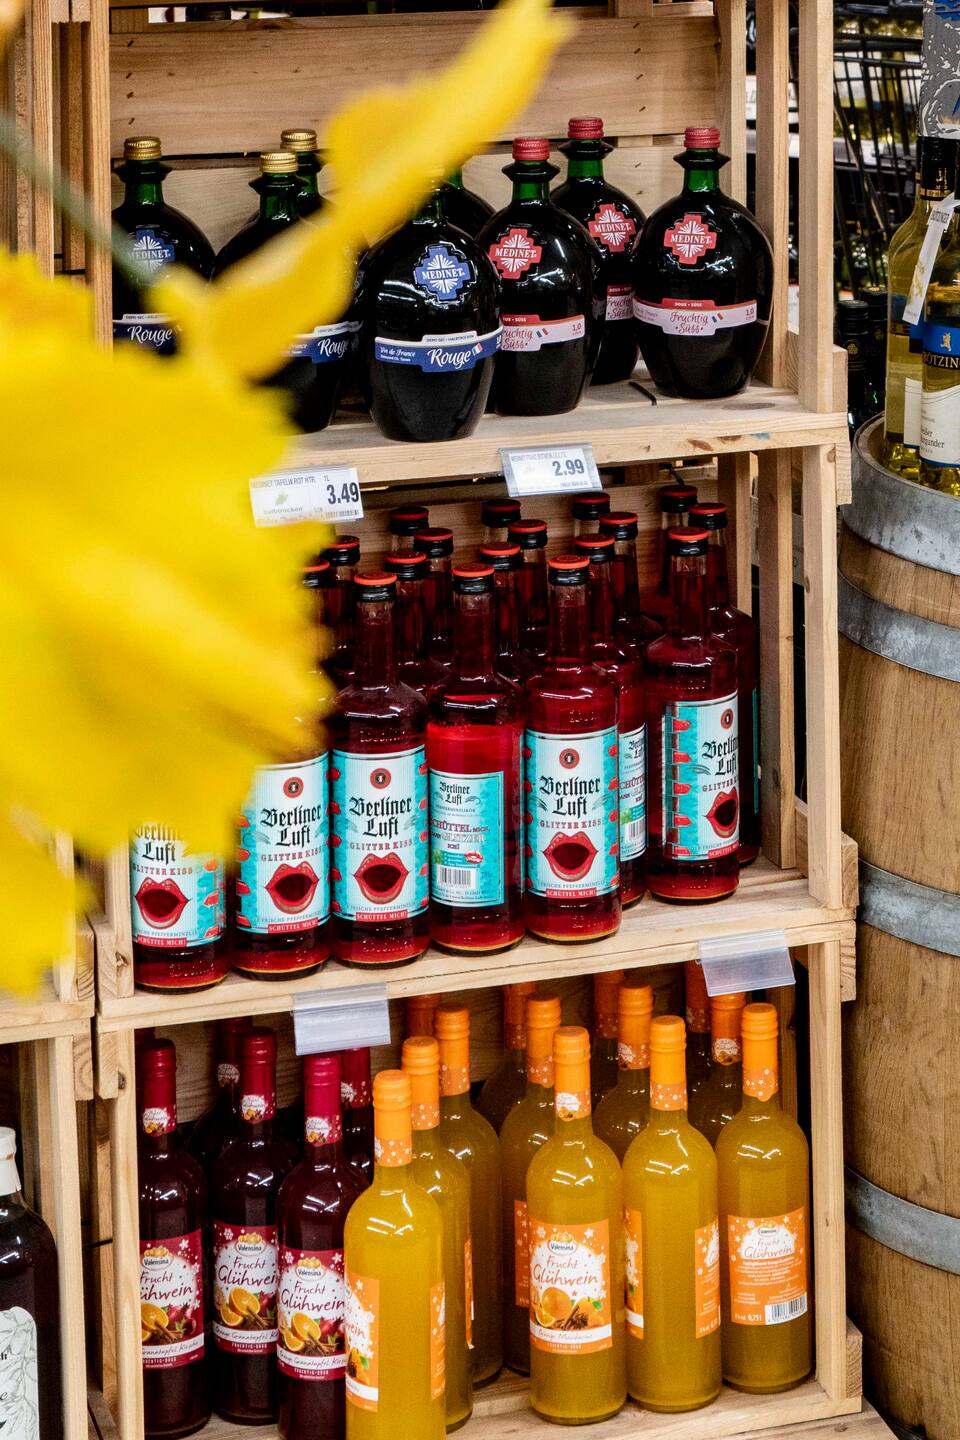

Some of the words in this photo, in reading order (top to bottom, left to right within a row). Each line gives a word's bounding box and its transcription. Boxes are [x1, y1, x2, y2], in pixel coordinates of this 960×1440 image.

[593, 221, 632, 234] MEDINET
[670, 234, 710, 245] MEDINET
[494, 247, 536, 259] MEDINET
[421, 268, 464, 281] MEDINET
[669, 311, 709, 326] Fruchtig
[127, 324, 173, 350] Rouge
[427, 348, 472, 370] Rouge
[551, 458, 585, 477] 2.99
[326, 482, 360, 505] 3.49
[439, 781, 471, 795] Berliner
[539, 775, 601, 796] Berliner
[444, 793, 463, 806] Luft
[349, 796, 413, 818] Berliner
[551, 795, 588, 819] Luft
[260, 803, 322, 828] Berliner
[363, 816, 399, 839] Luft
[539, 819, 579, 830] GLITTER
[581, 818, 602, 829] KISS
[275, 824, 311, 848] Luft
[349, 840, 392, 851] GLITTER
[392, 838, 413, 850] KISS
[142, 842, 176, 865] Luft
[261, 850, 304, 862] GLITTER
[305, 847, 322, 859] KISS
[132, 865, 168, 876] GLITTER
[170, 866, 193, 876] KISS
[546, 889, 577, 898] SCHÜTTEL
[577, 888, 597, 897] MICH!
[356, 911, 388, 921] SCHÜTTEL
[389, 910, 408, 920] MICH!
[269, 922, 300, 932] SCHÜTTEL
[300, 919, 319, 929] MICH!
[166, 936, 186, 946] MICH!
[549, 1243, 574, 1253] Valensina
[744, 1246, 795, 1259] Glühwein
[144, 1257, 170, 1267] Valensina
[233, 1258, 266, 1270] Frucht
[546, 1256, 580, 1270] Frucht
[140, 1271, 173, 1285] Frucht
[297, 1268, 323, 1277] Valensina
[532, 1264, 599, 1287] Glühwein
[140, 1285, 193, 1300] ühwein
[294, 1280, 326, 1295] Frucht
[281, 1288, 345, 1312] Glühwein
